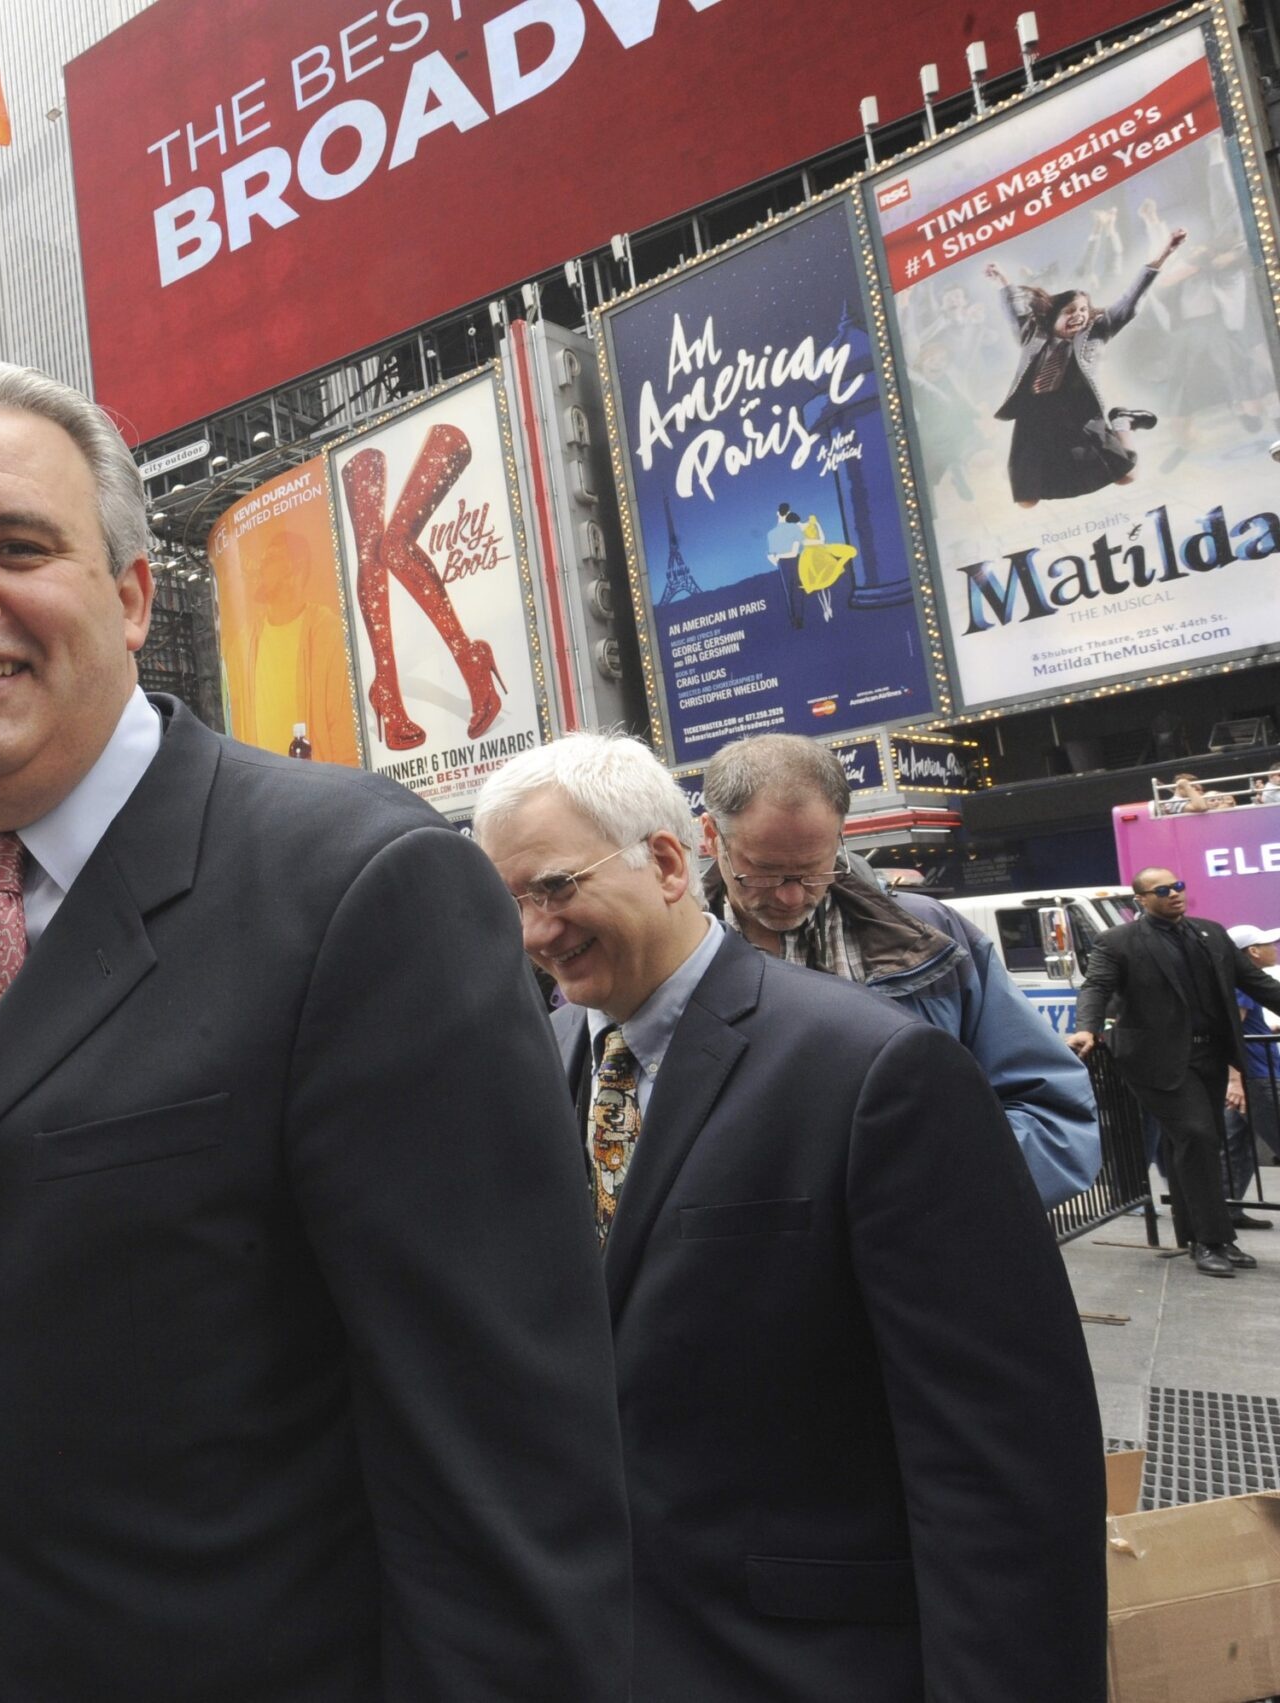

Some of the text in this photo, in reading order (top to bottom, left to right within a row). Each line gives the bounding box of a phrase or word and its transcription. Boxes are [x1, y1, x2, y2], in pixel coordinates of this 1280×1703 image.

[148, 77, 272, 187] THE
[917, 104, 1162, 242] TIME Magazine's
[905, 113, 1198, 280] #1 Show of the Year!
[668, 313, 722, 393] An
[636, 336, 865, 471] American
[144, 445, 205, 475] city outdoor
[675, 406, 820, 501] Paris
[233, 473, 312, 525] KEVIN DURANT
[235, 484, 322, 538] LIMITED EDITION
[1041, 512, 1131, 545] Roald Dahl's
[442, 534, 511, 584] Boots
[956, 504, 1280, 636] Matilda
[669, 599, 767, 637] AN AMERICAN IN PARIS
[1067, 593, 1175, 624] THE MUSICAL
[672, 629, 746, 658] GEORGE GERSHWIN
[684, 654, 698, 666] IRA
[699, 642, 740, 662] GERSHWIN
[1032, 625, 1231, 677] MatildaTheMusical.com
[1041, 645, 1084, 661] Shubert
[1137, 627, 1159, 638] 225
[1180, 617, 1208, 630] 44th
[676, 667, 727, 689] CRAIG LUCAS
[679, 677, 779, 710] CHRISTOPHER WHEELDON
[431, 753, 439, 772] 6
[441, 744, 476, 769] TONY
[480, 730, 534, 761] AWARDS
[436, 767, 469, 784] BEST
[1205, 843, 1280, 878] ELE
